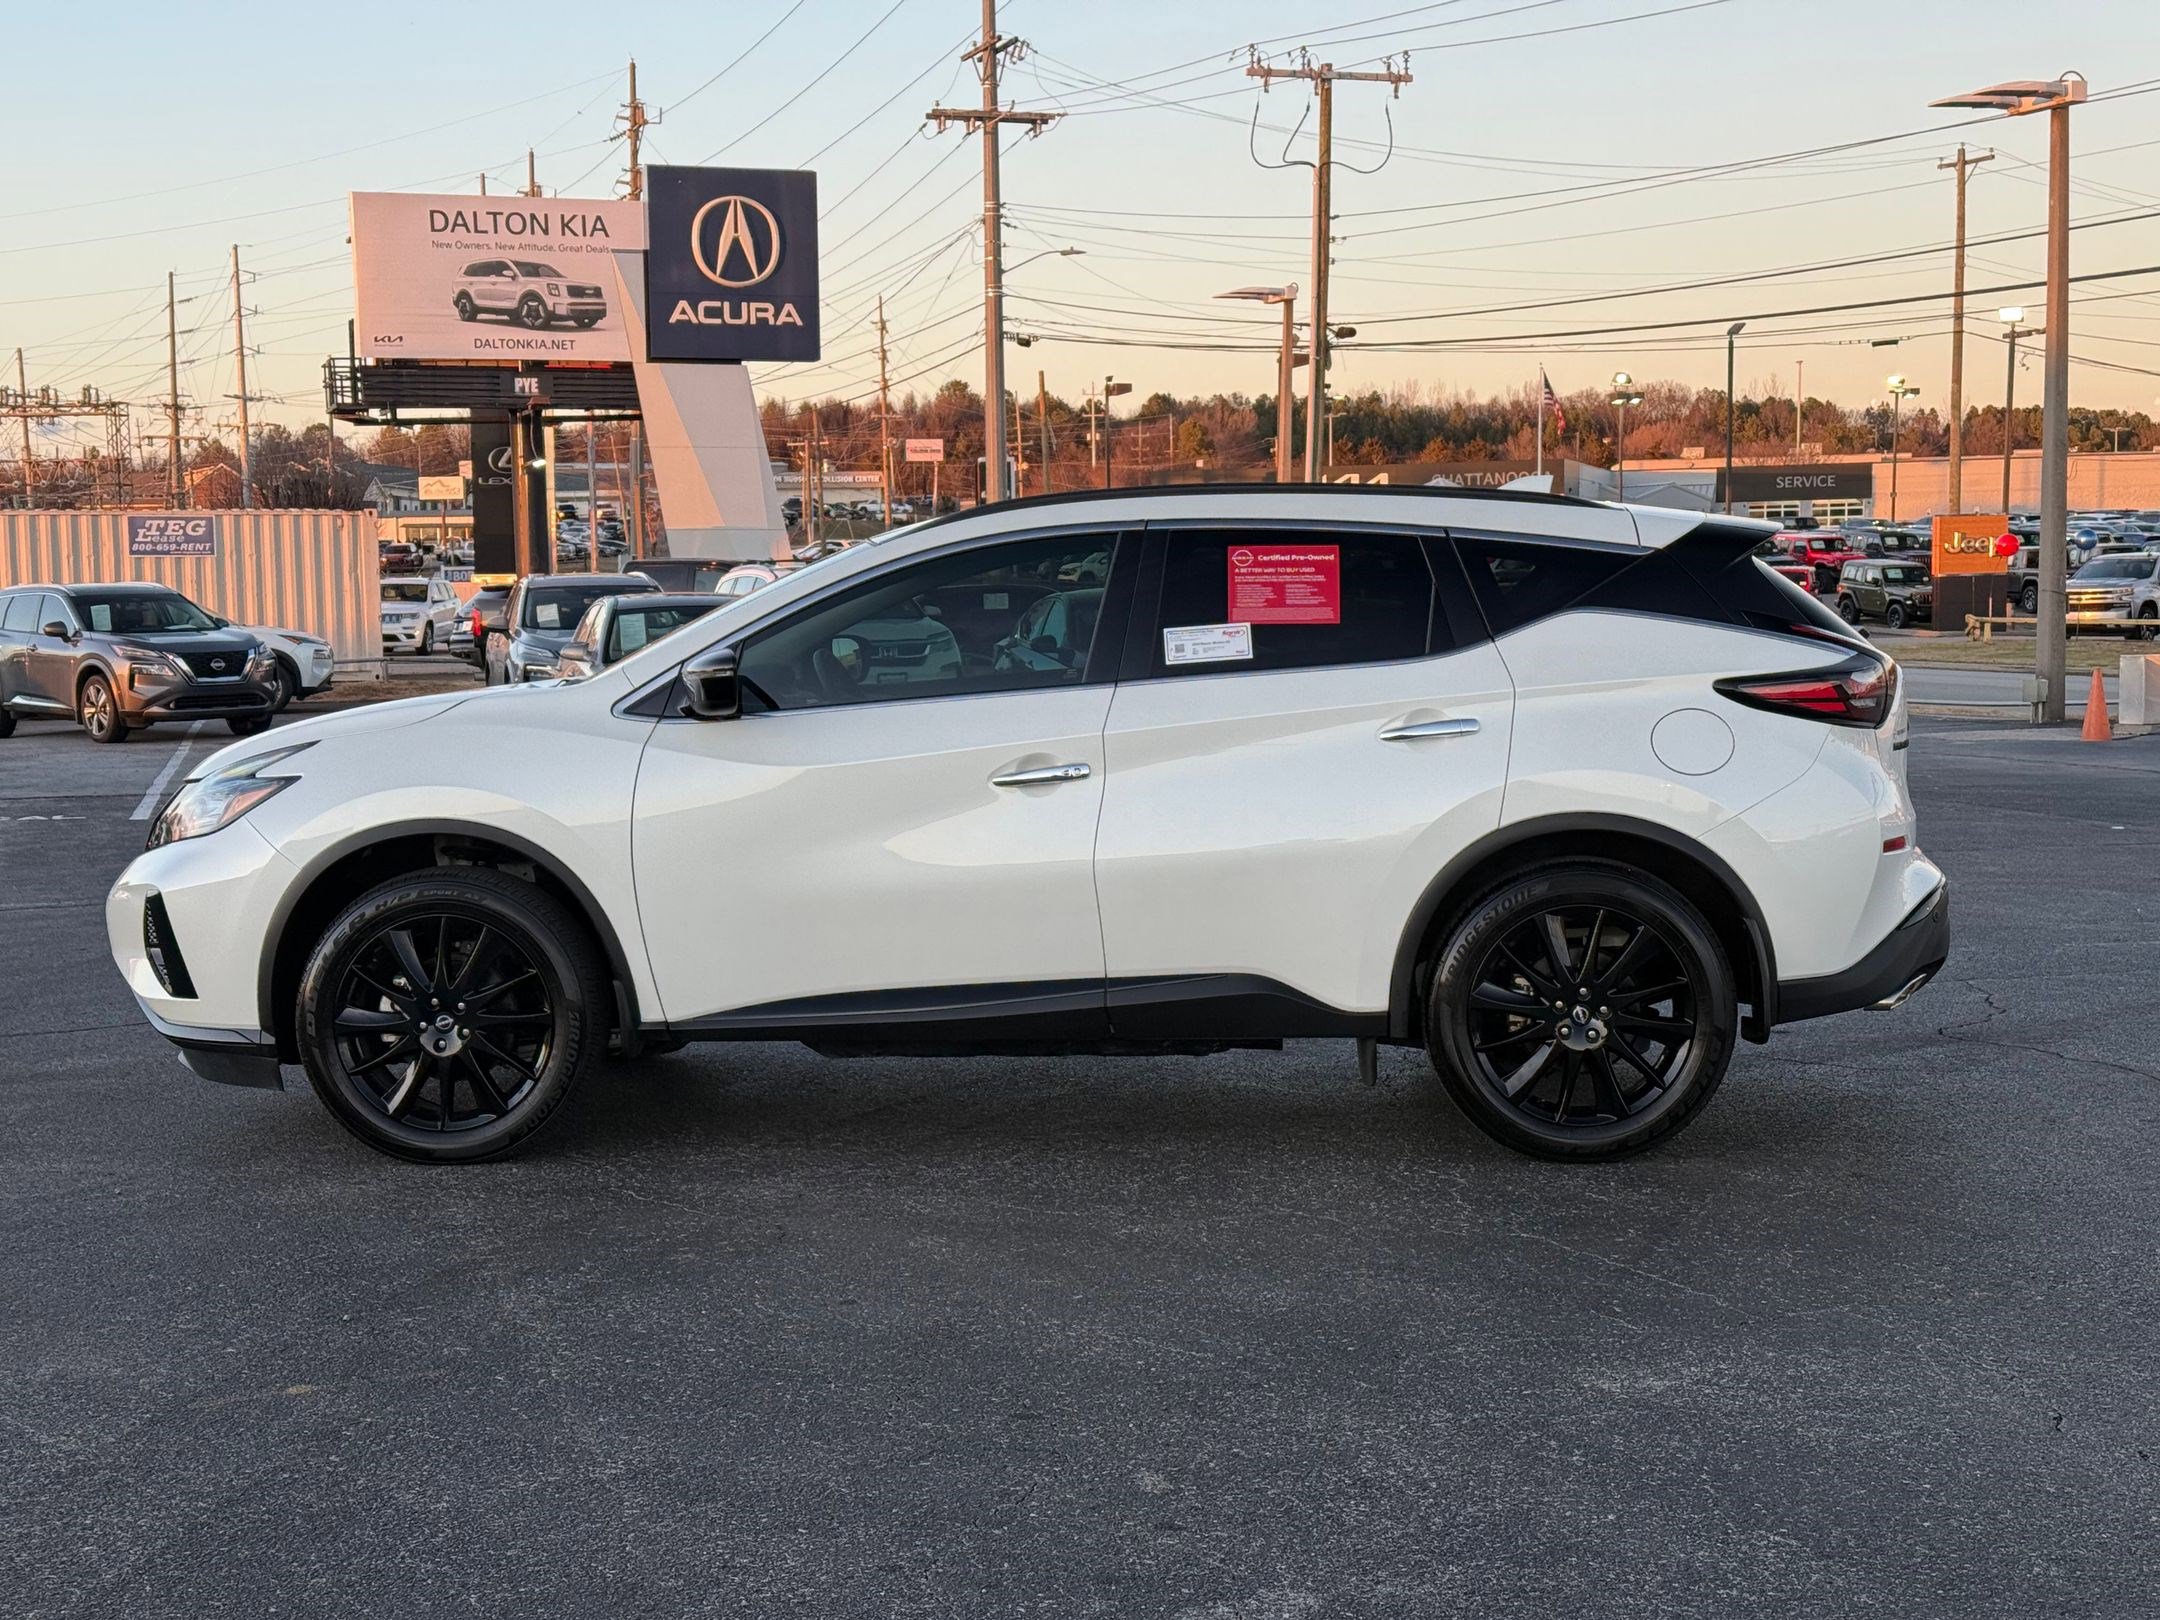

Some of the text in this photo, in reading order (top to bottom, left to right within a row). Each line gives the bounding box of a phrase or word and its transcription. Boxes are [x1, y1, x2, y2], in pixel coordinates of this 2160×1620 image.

[429, 209, 610, 238] DALTON KIA
[431, 240, 453, 249] New
[454, 240, 492, 250] Owners.
[495, 242, 516, 250] New
[518, 241, 557, 252] Attitude.
[558, 243, 583, 253] Great
[668, 299, 804, 326] ACURA
[474, 338, 576, 350] DALTONKIA.NET
[514, 377, 539, 393] PYE
[478, 476, 513, 485] LEX
[1431, 470, 1551, 486] CHATTANO
[1776, 475, 1837, 489] SERVICE
[135, 528, 185, 542] Lease
[144, 519, 206, 536] TEG
[131, 543, 212, 551] 800-659-RENT
[305, 907, 369, 1038] DUELER
[515, 1009, 584, 1137] BRIDGESTONE
